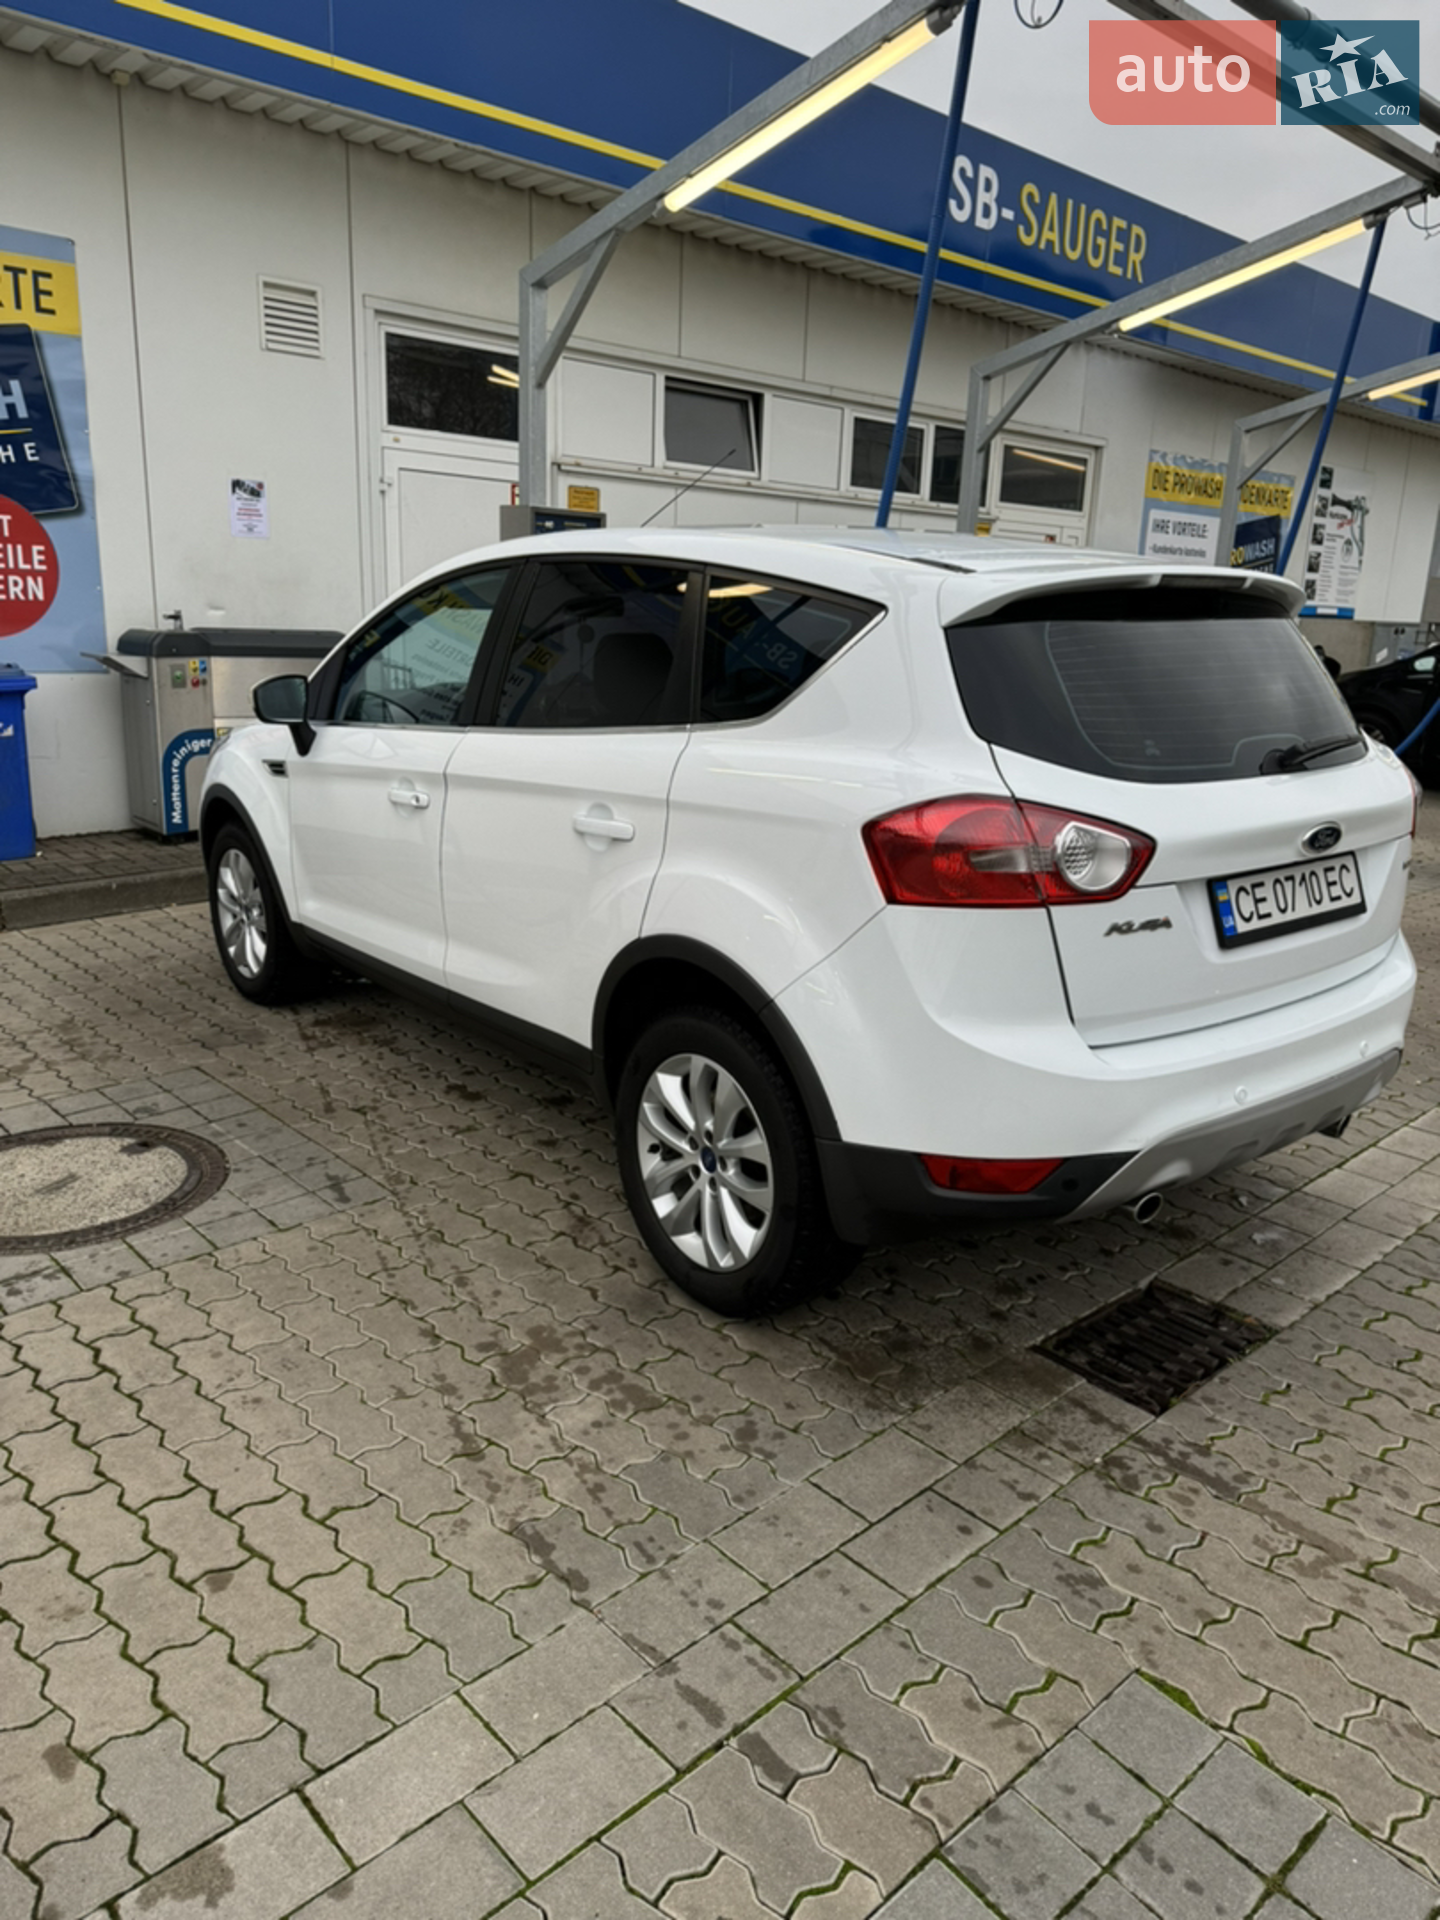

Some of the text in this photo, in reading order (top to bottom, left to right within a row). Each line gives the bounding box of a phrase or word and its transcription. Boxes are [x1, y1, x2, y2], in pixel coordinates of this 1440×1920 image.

[948, 154, 1147, 284] SB-SAUGER
[0, 264, 56, 316] TE
[1152, 468, 1170, 493] DIE
[1172, 472, 1223, 500] PROWASH
[1152, 518, 1170, 535] IHRE
[171, 738, 212, 824] Mattenreiniger
[1235, 864, 1354, 923] CE 0710 EC
